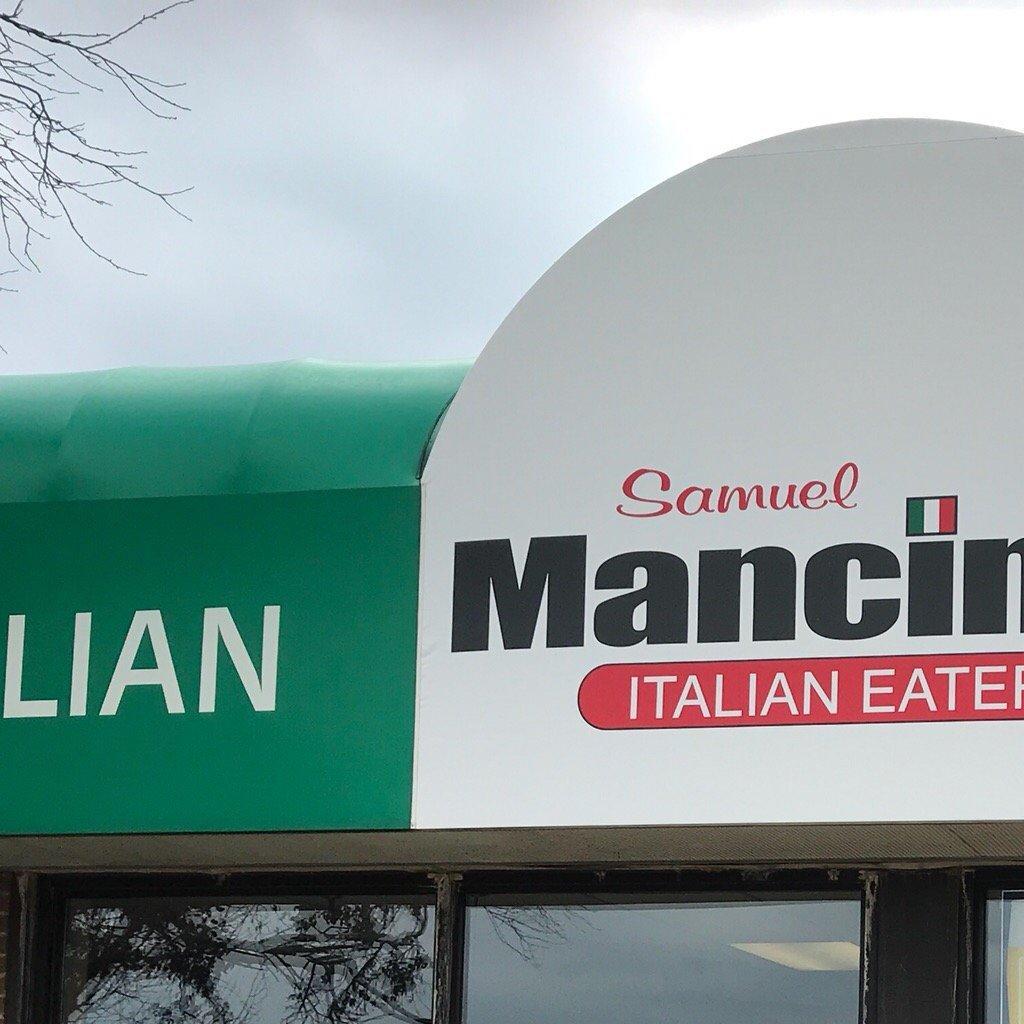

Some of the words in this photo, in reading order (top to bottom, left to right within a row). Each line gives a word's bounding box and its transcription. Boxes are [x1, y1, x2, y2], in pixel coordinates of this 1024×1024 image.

[617, 462, 860, 519] Samuel
[4, 606, 281, 718] LIAN
[629, 672, 841, 720] ITALIAN
